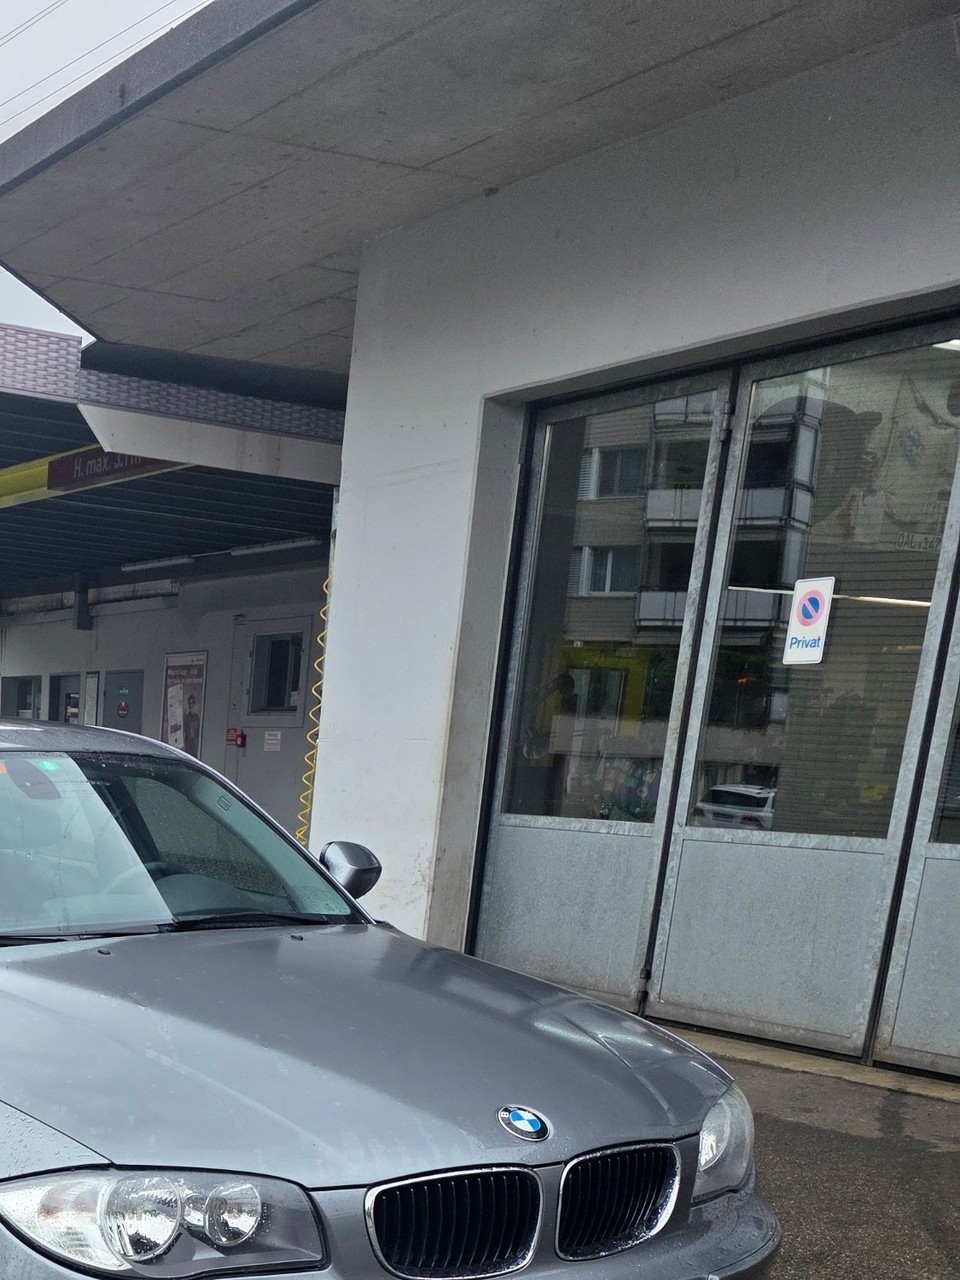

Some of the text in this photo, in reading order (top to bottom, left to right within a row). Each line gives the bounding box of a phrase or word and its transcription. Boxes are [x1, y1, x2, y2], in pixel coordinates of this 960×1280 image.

[73, 458, 84, 478] H.
[86, 456, 111, 475] max.
[789, 635, 822, 649] Privat
